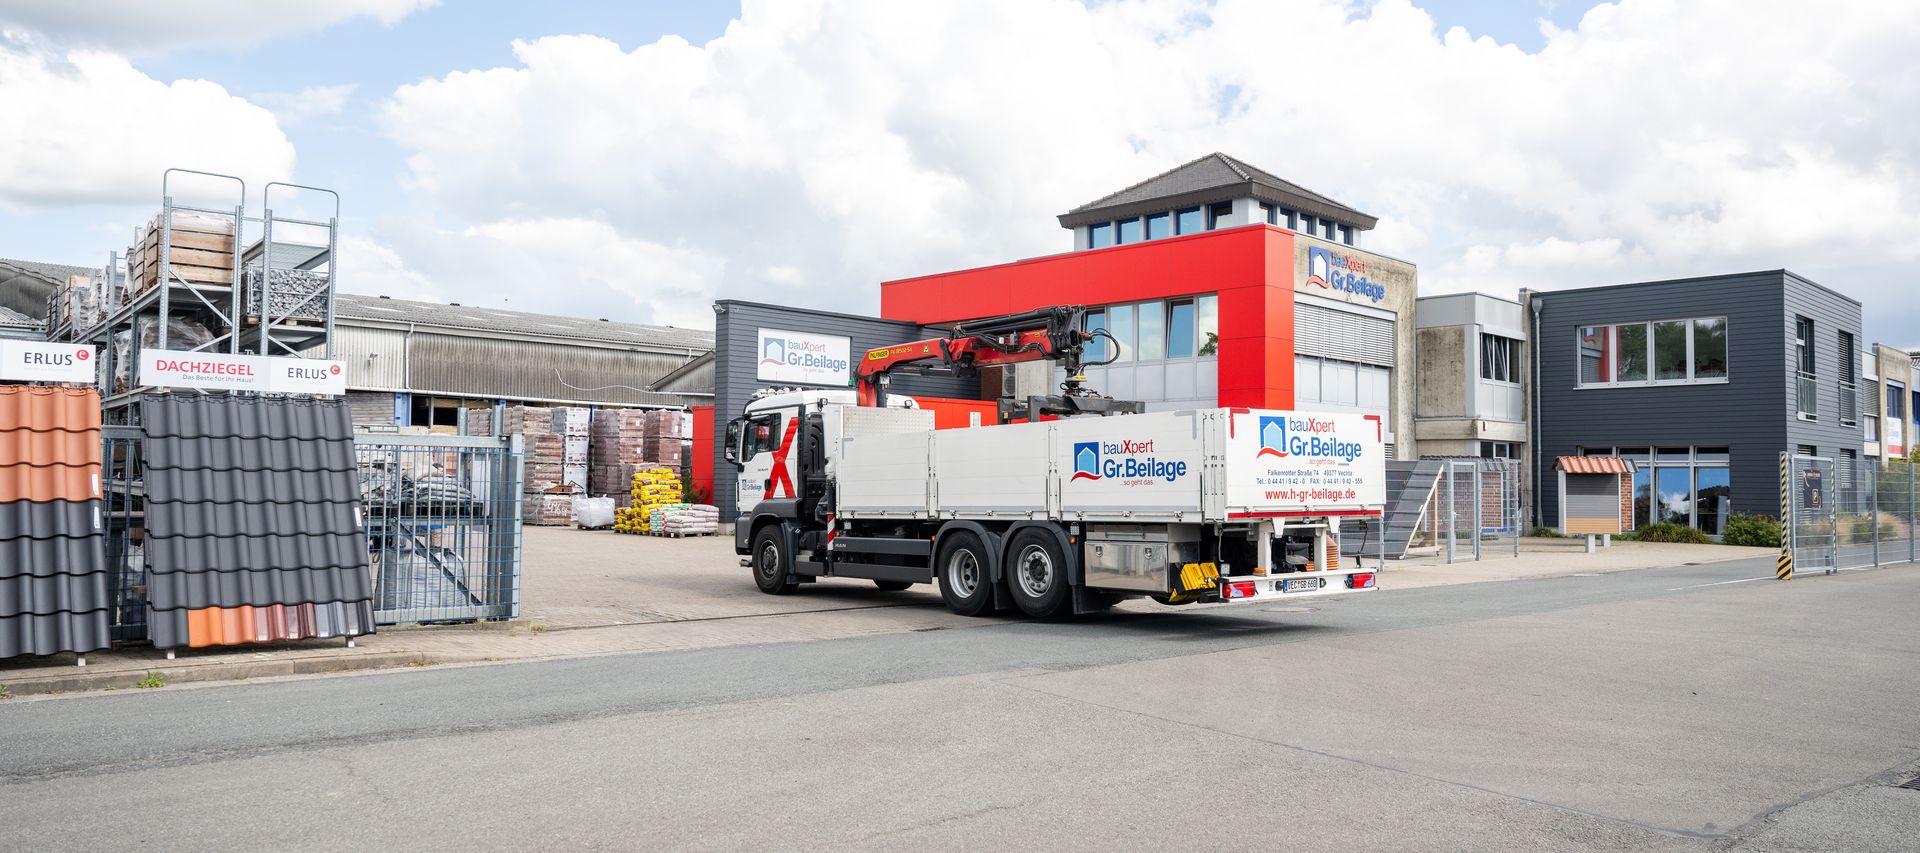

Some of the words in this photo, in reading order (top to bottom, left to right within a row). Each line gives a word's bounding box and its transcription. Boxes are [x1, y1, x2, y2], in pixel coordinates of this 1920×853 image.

[1331, 252, 1365, 273] bauXpert
[1331, 270, 1384, 303] Gr.Beilage
[788, 340, 826, 352] bauXpert
[24, 352, 72, 366] ERLUS
[788, 352, 846, 372] Gr.Beilage
[156, 360, 254, 376] DACHZIEGEL
[288, 368, 327, 380] ERLUS
[1290, 417, 1335, 435] bauXpert
[1103, 440, 1154, 456] bauXpert
[1290, 436, 1362, 462] Gr.Beilage
[1103, 458, 1186, 482] Gr.Beilage
[1265, 488, 1356, 502] www.h-gr-beilage.de
[1288, 580, 1297, 589] VEC
